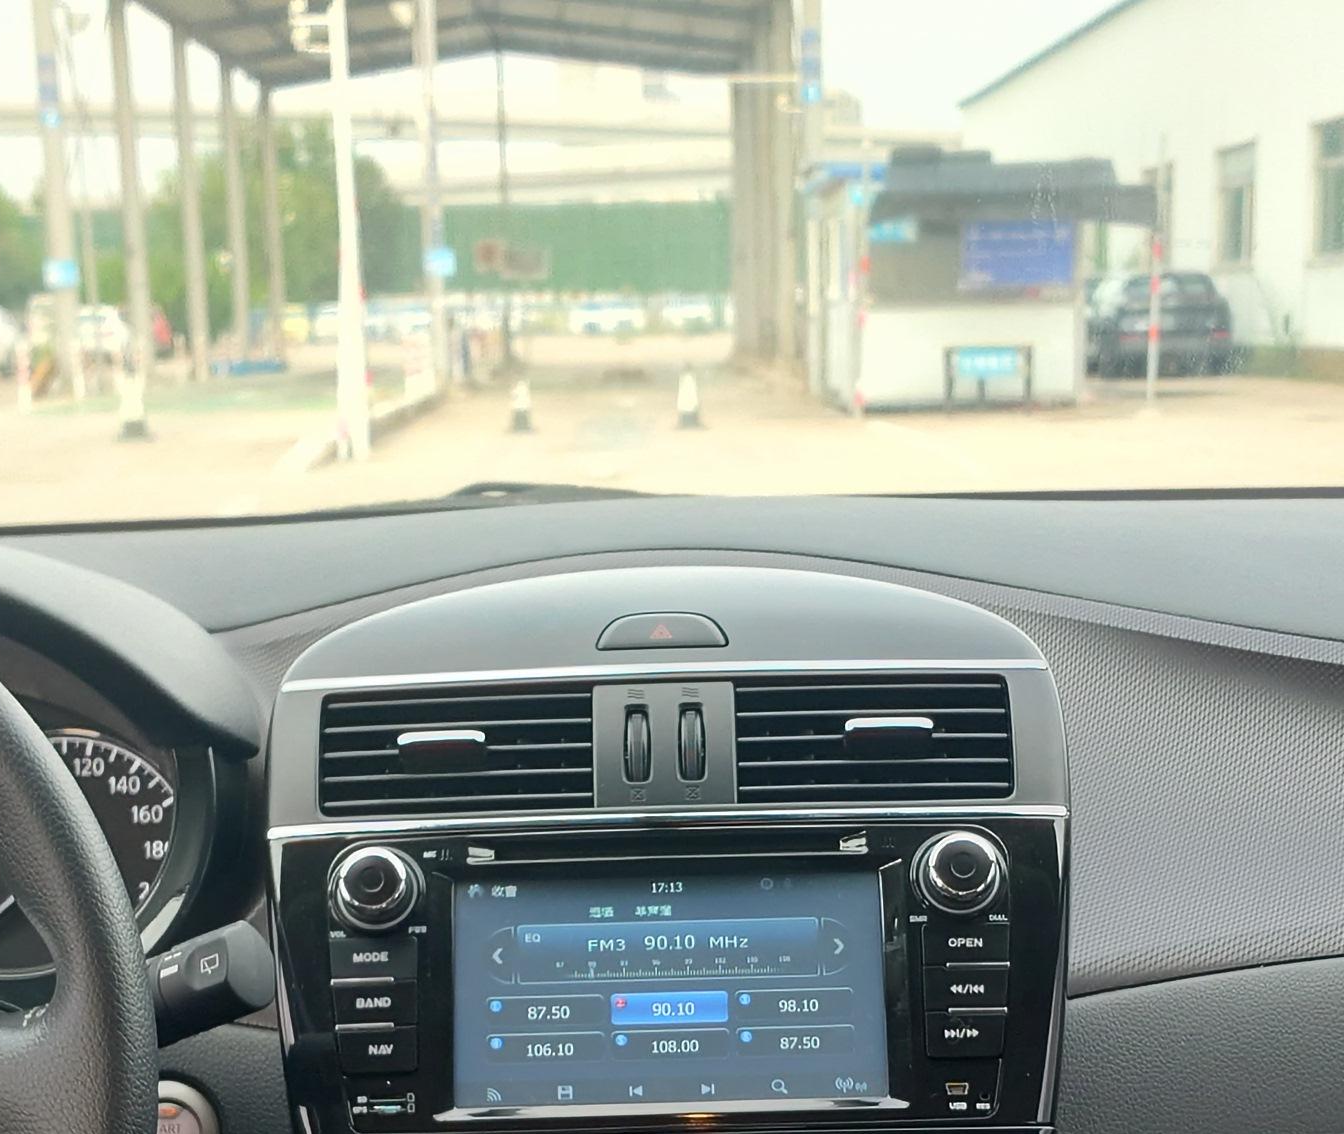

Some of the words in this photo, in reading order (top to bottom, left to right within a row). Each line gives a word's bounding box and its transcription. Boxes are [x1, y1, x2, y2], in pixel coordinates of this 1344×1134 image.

[73, 757, 105, 777] 120
[108, 775, 141, 795] 140
[131, 804, 164, 823] 160
[651, 882, 683, 893] 17:13
[525, 933, 541, 943] EQ
[588, 939, 626, 952] FM3
[644, 934, 695, 951] 90.10
[709, 936, 749, 949] MHz
[948, 937, 983, 948] OPEN
[352, 951, 389, 963] MODE
[356, 997, 392, 1009] BAND
[652, 1002, 695, 1017] 90.10
[778, 999, 819, 1013] 98.10
[527, 1006, 570, 1020] 87.50
[368, 1044, 394, 1055] NAV
[526, 1043, 574, 1057] 106.10
[651, 1039, 699, 1053] 108.00
[779, 1036, 820, 1050] 87.50
[159, 1124, 181, 1134] ART
